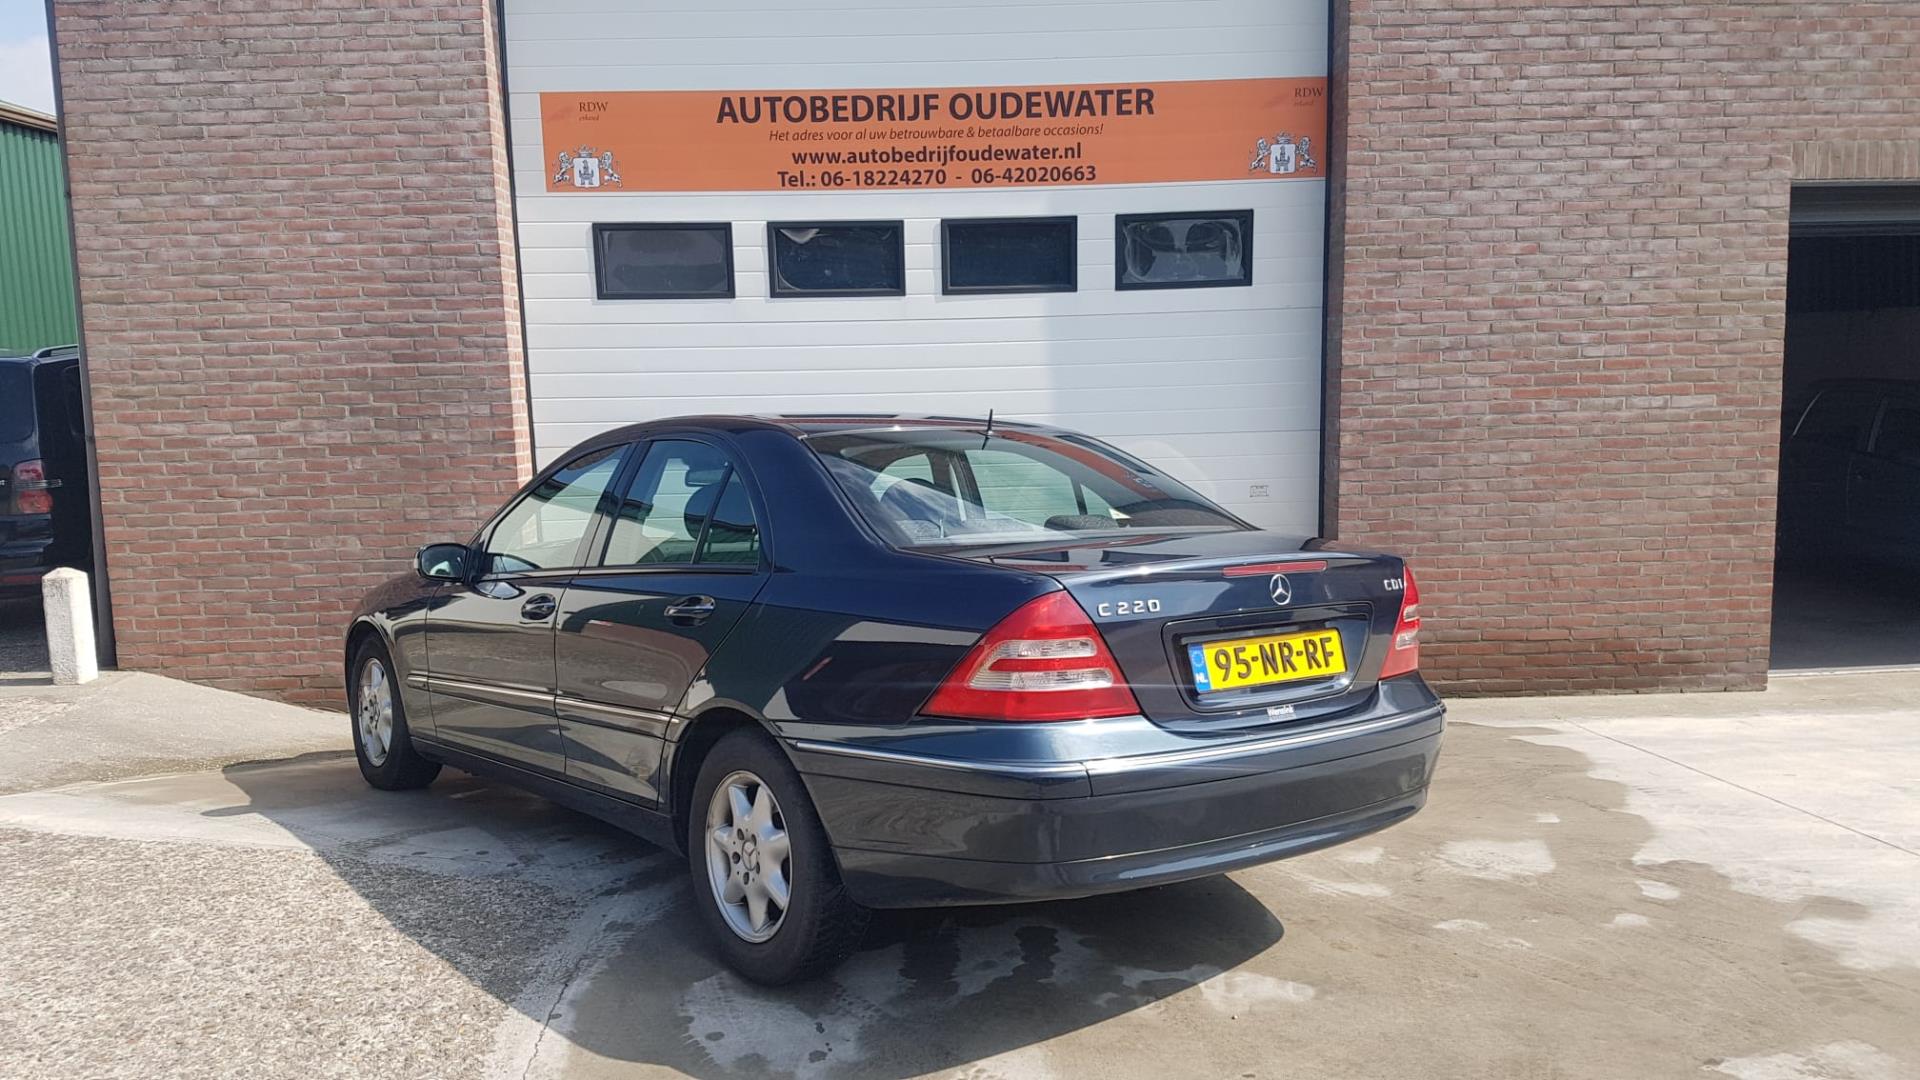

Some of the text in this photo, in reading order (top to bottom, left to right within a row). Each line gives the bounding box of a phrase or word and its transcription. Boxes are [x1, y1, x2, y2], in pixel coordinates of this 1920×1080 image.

[1294, 87, 1324, 97] RDW
[579, 101, 608, 112] RDW
[716, 88, 1155, 123] AUTOBEDRIJF OUDEWATER
[769, 123, 1104, 141] Het adres voor al uw betrouwbare & betaalbare occasions!
[792, 142, 1081, 166] www.autobedrijfoudewater.nl
[777, 170, 816, 187] Tel.:
[820, 169, 946, 187] 06-18224270
[971, 165, 1096, 184] 06-42020663
[1383, 578, 1403, 591] CDI
[1097, 599, 1160, 617] C 220
[1214, 637, 1335, 683] 95-NR-RF
[1194, 672, 1209, 684] NL
